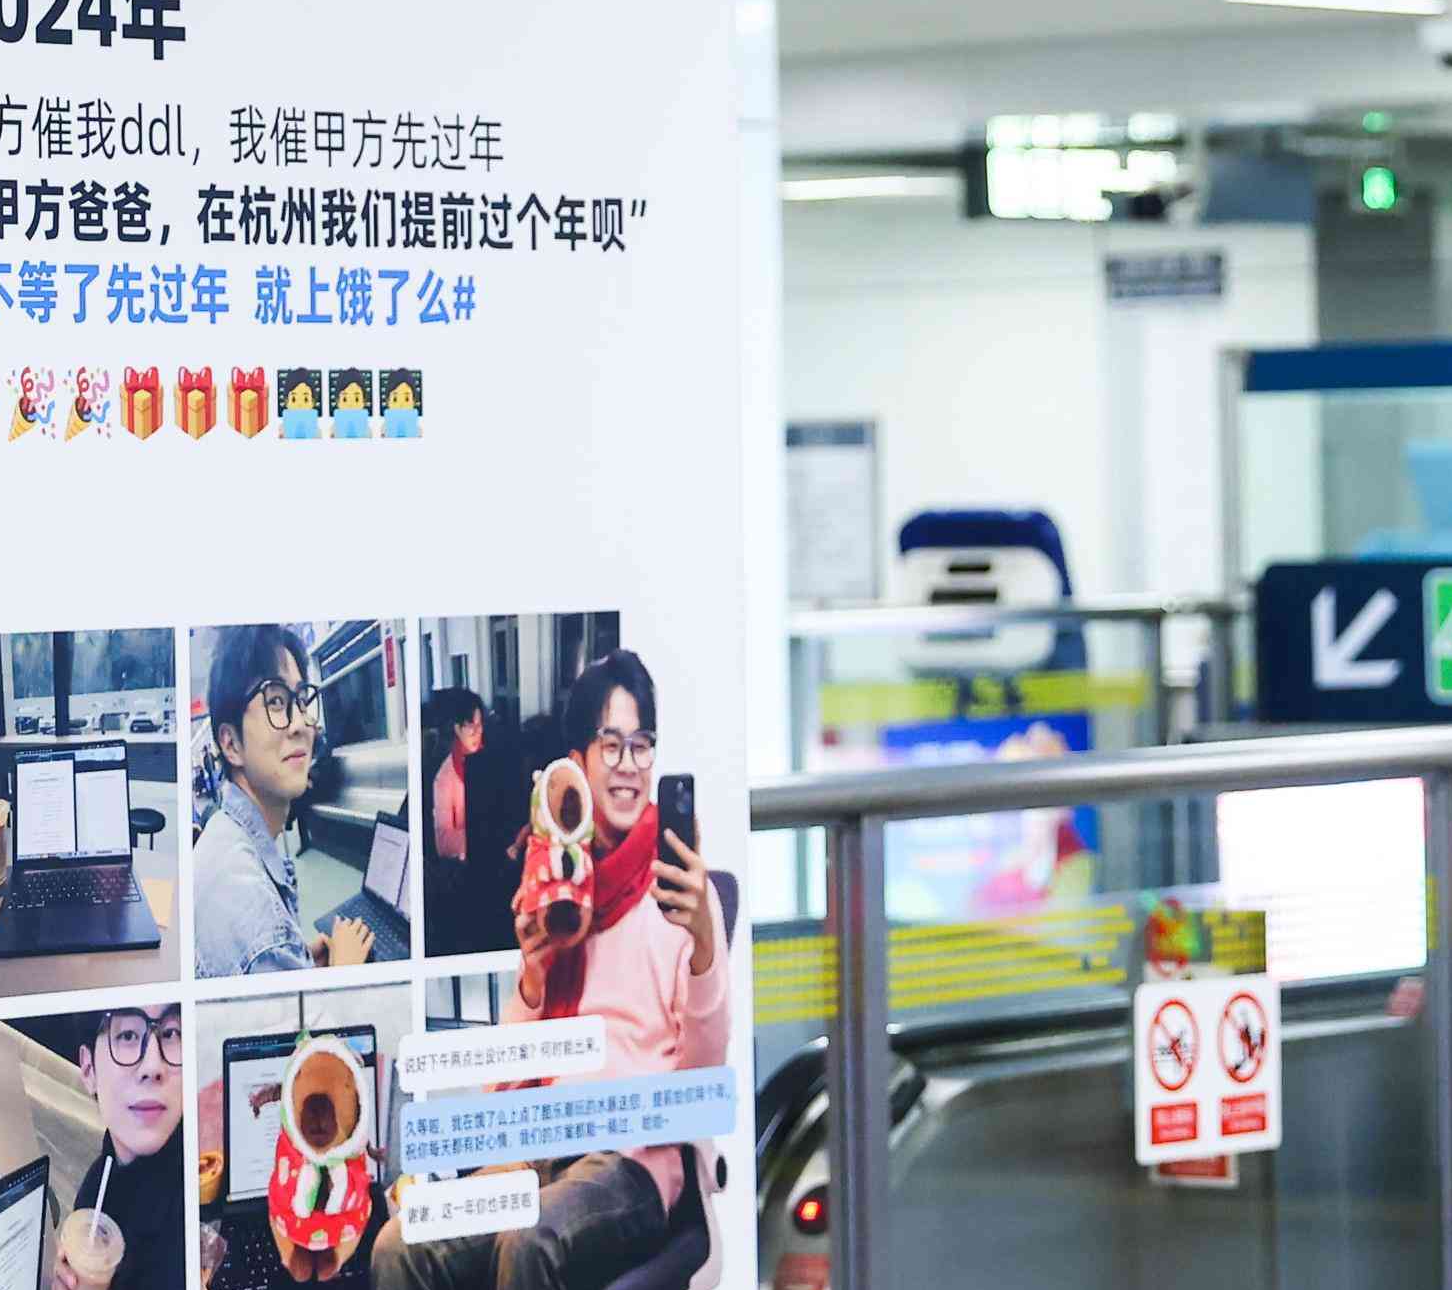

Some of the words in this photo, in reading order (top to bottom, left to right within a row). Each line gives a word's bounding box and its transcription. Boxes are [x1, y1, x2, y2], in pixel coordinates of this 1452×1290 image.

[253, 265, 477, 326] 就上饿了么#
